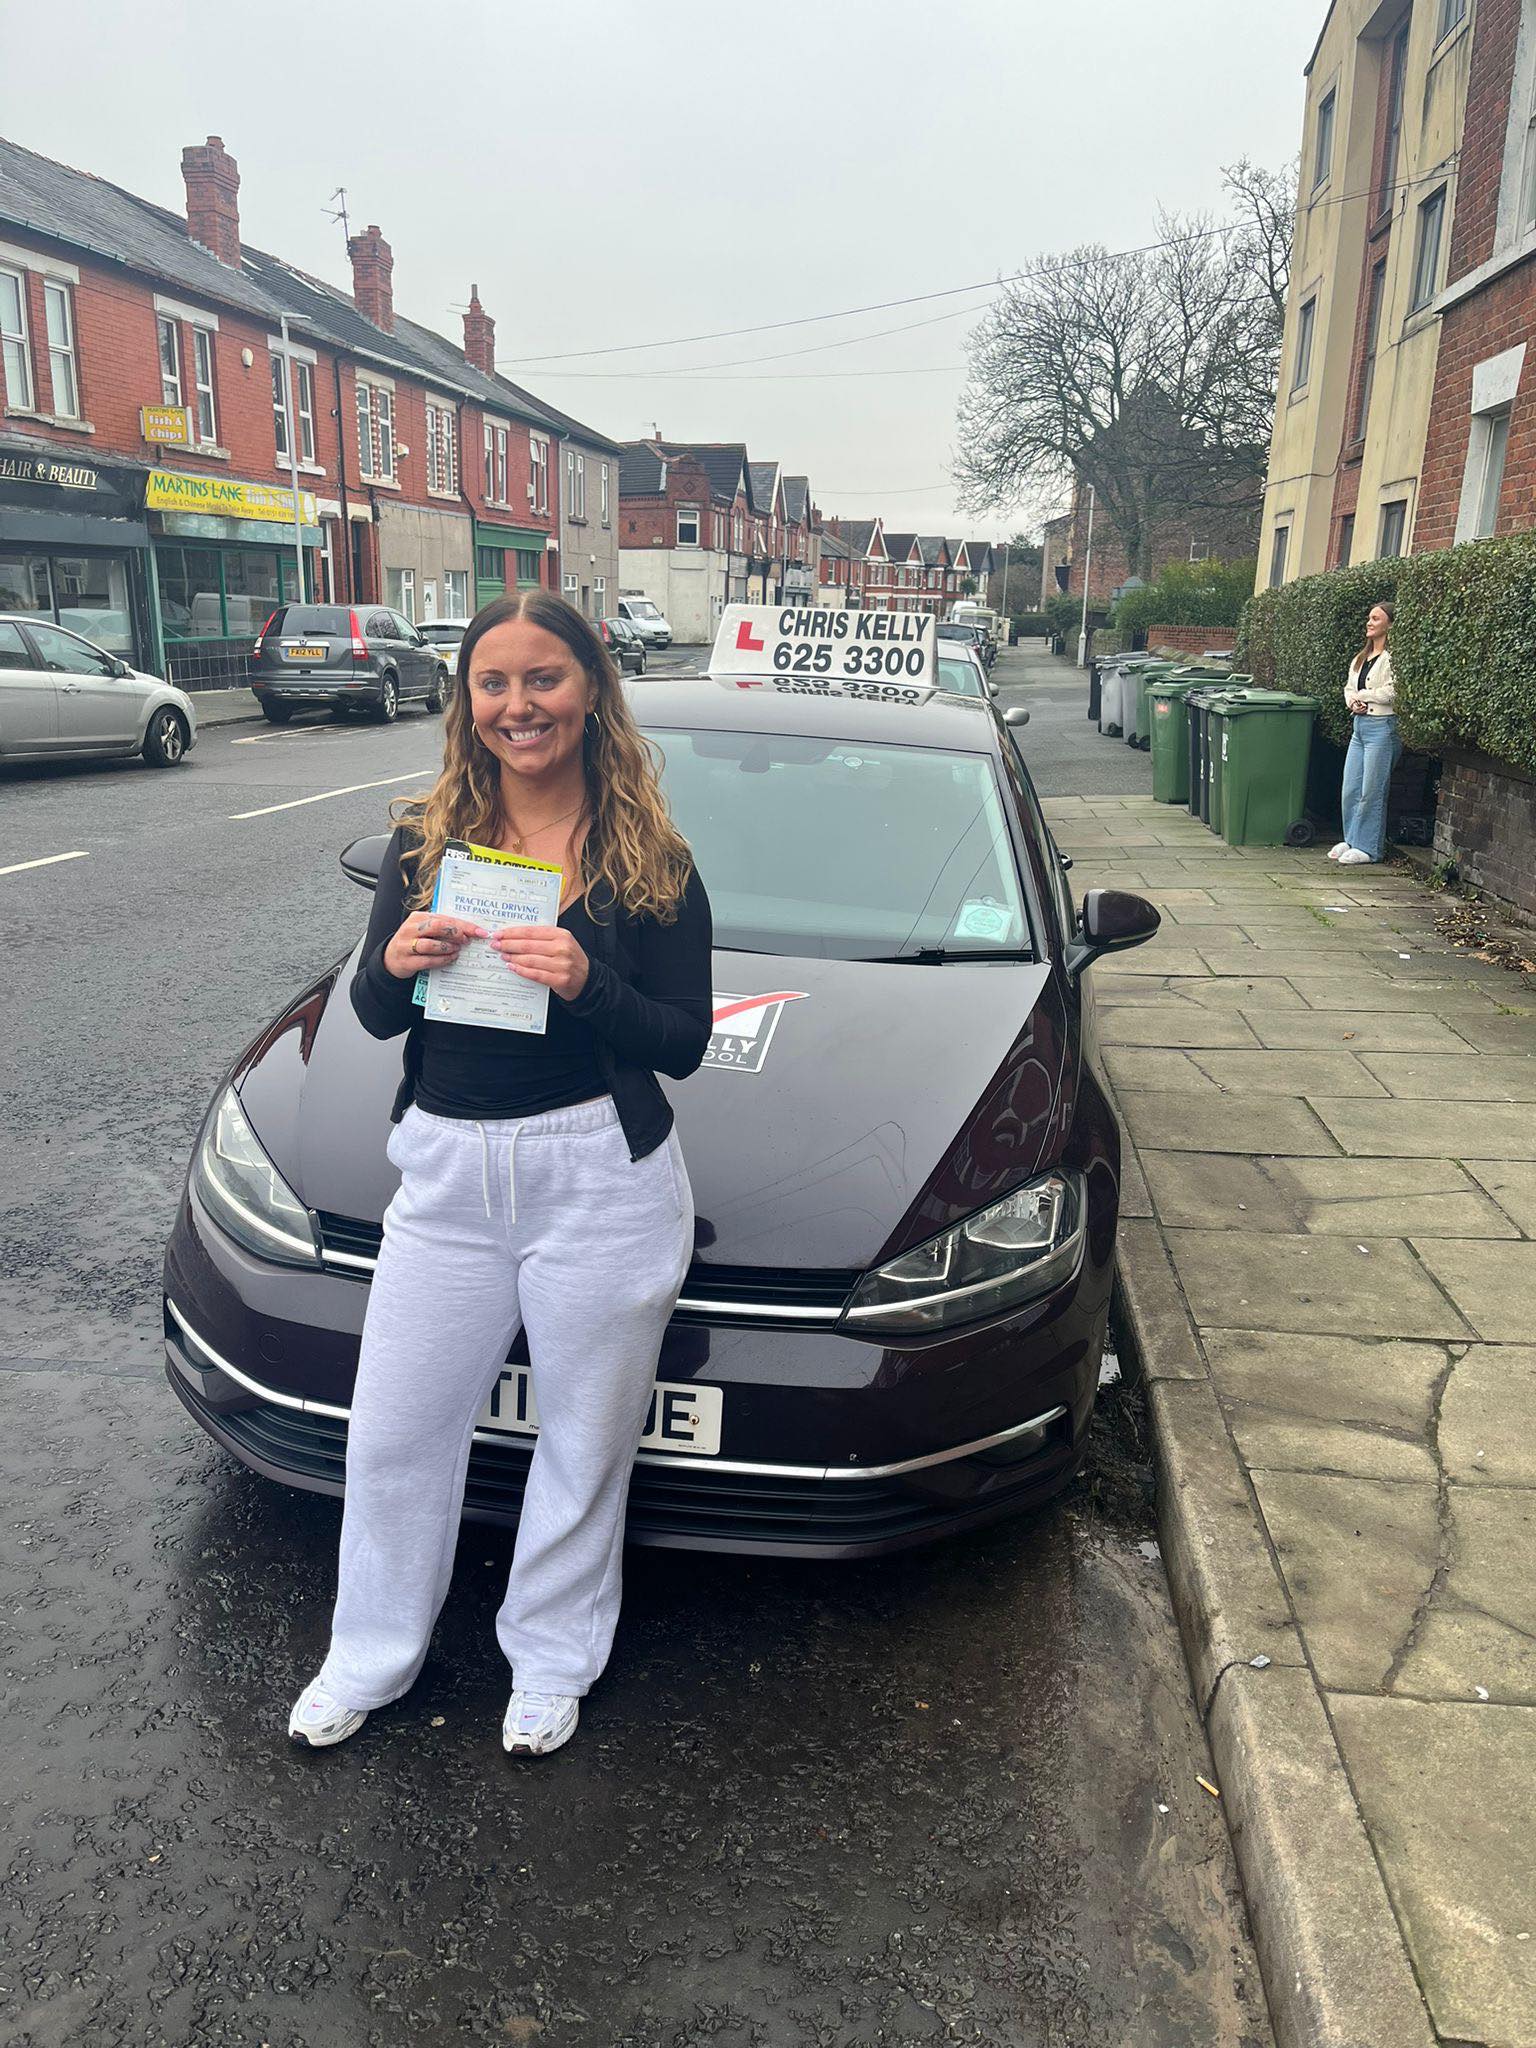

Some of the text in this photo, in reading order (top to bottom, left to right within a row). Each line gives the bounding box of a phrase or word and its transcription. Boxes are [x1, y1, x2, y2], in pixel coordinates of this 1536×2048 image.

[0, 458, 99, 486] HAIR & BEAUTY
[154, 475, 208, 498] MARTINS
[211, 483, 243, 501] LANE
[736, 621, 764, 652] L
[779, 608, 930, 642] CHRIS KELLY
[773, 642, 925, 676] 625 3300
[455, 895, 539, 915] PRACTICAL DRIVING
[455, 904, 471, 913] TEST
[473, 906, 490, 916] PASS
[492, 909, 538, 922] CERTIFICATE
